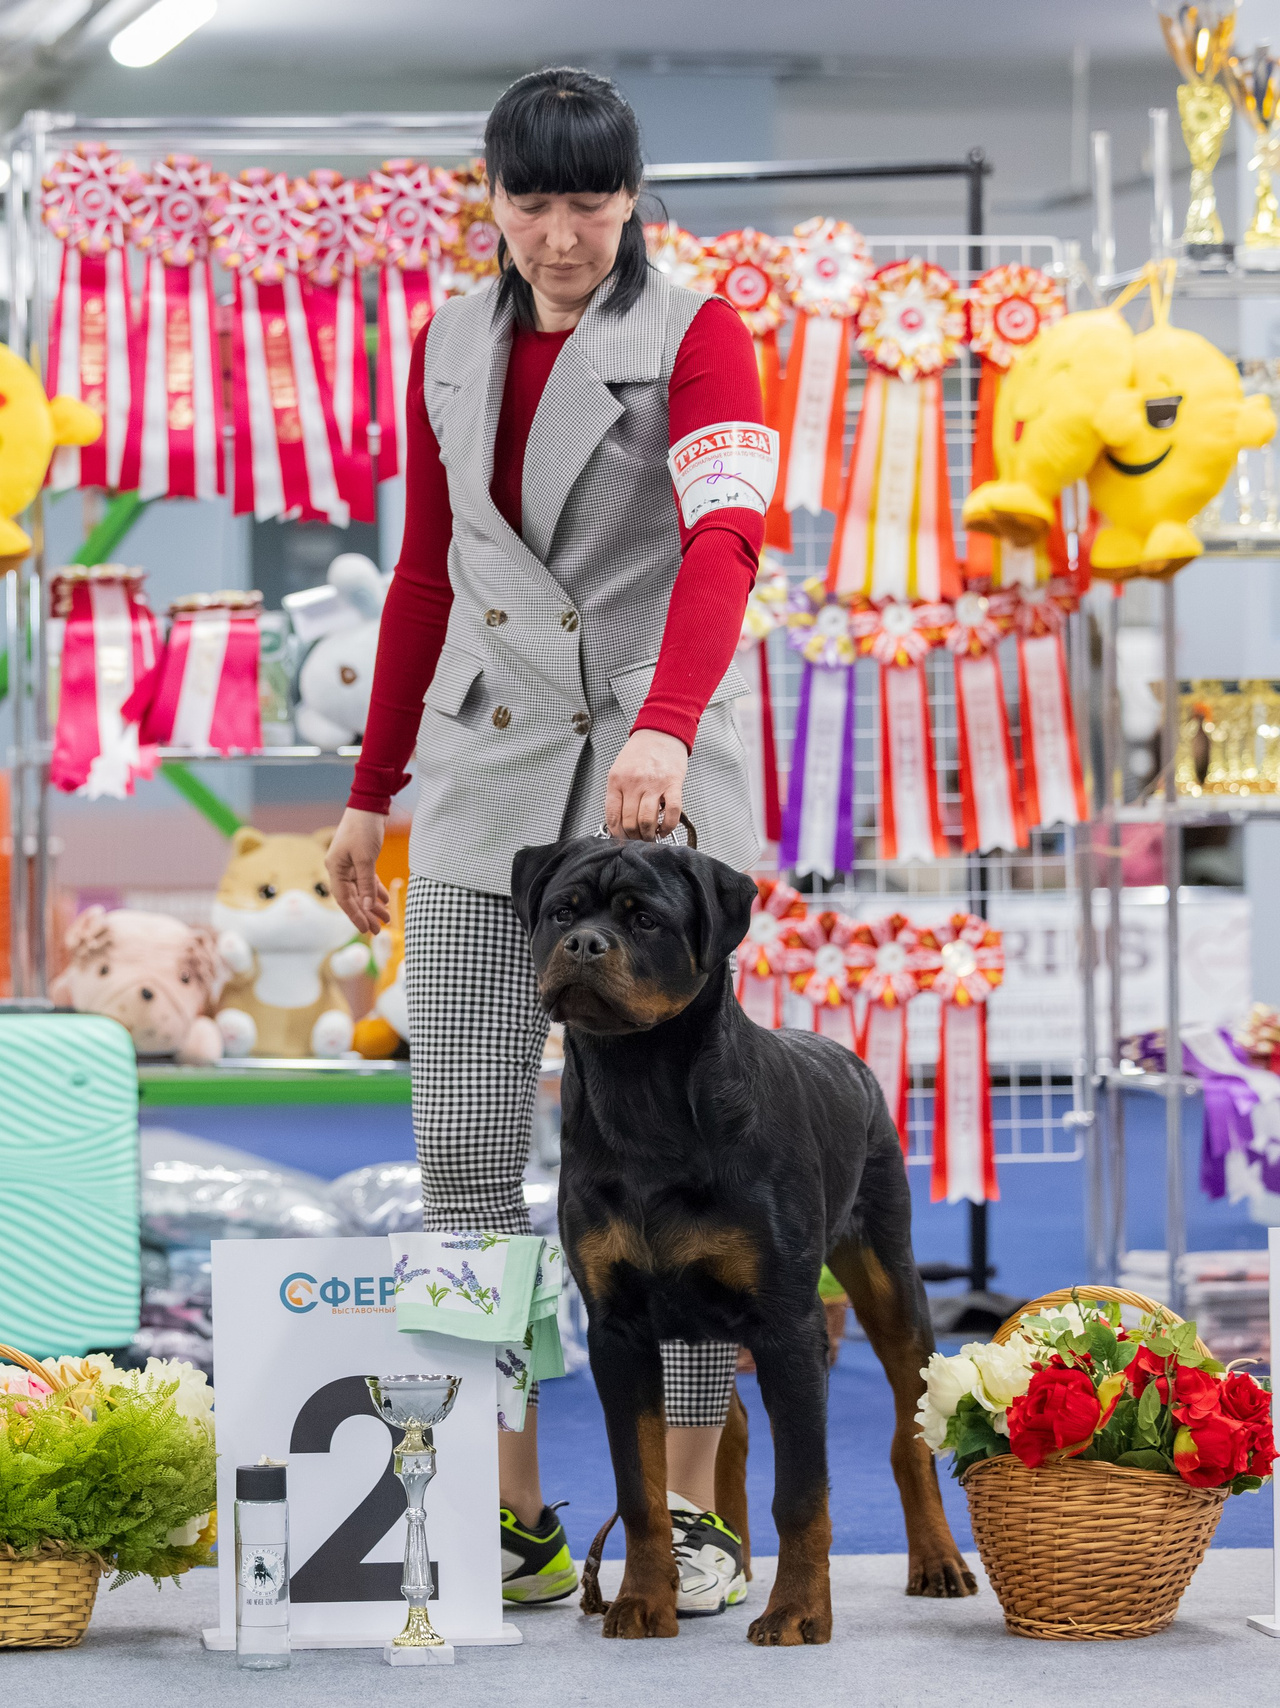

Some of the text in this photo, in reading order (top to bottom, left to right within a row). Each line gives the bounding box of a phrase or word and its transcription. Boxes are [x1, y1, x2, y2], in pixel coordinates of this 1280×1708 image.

[675, 430, 770, 470] ТРАПЕЗА
[279, 1272, 397, 1314] СФЕР
[331, 1305, 397, 1315] ВЫСТАВОЧНЫЙ
[289, 1374, 439, 1604] 2
